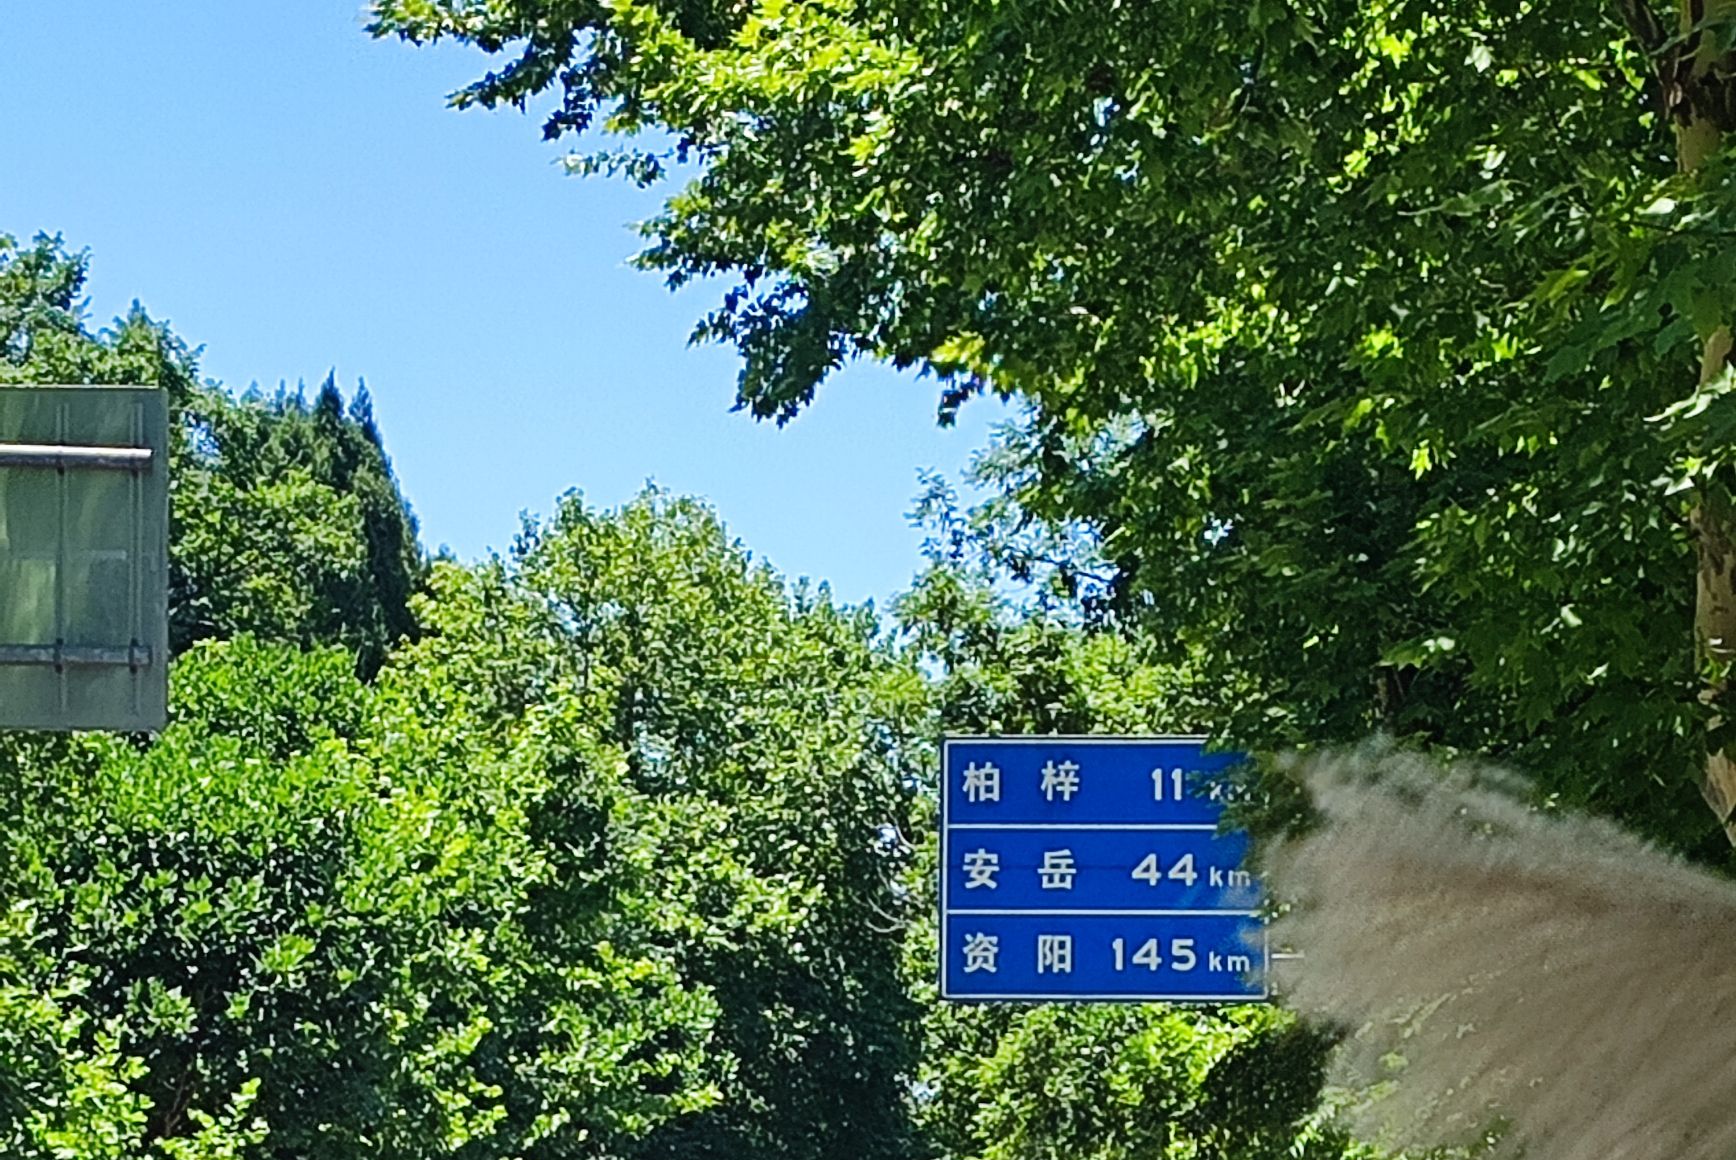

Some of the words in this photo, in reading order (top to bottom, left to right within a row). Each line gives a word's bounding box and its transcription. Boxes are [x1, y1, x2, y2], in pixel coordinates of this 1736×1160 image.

[962, 760, 1081, 802] 柏梓
[1151, 768, 1182, 801] 11
[962, 848, 1077, 890] 安岳
[1131, 853, 1198, 886] 44
[1209, 865, 1251, 887] km
[962, 932, 1073, 974] 资阳
[1112, 937, 1197, 971] 145
[1208, 951, 1251, 973] km
